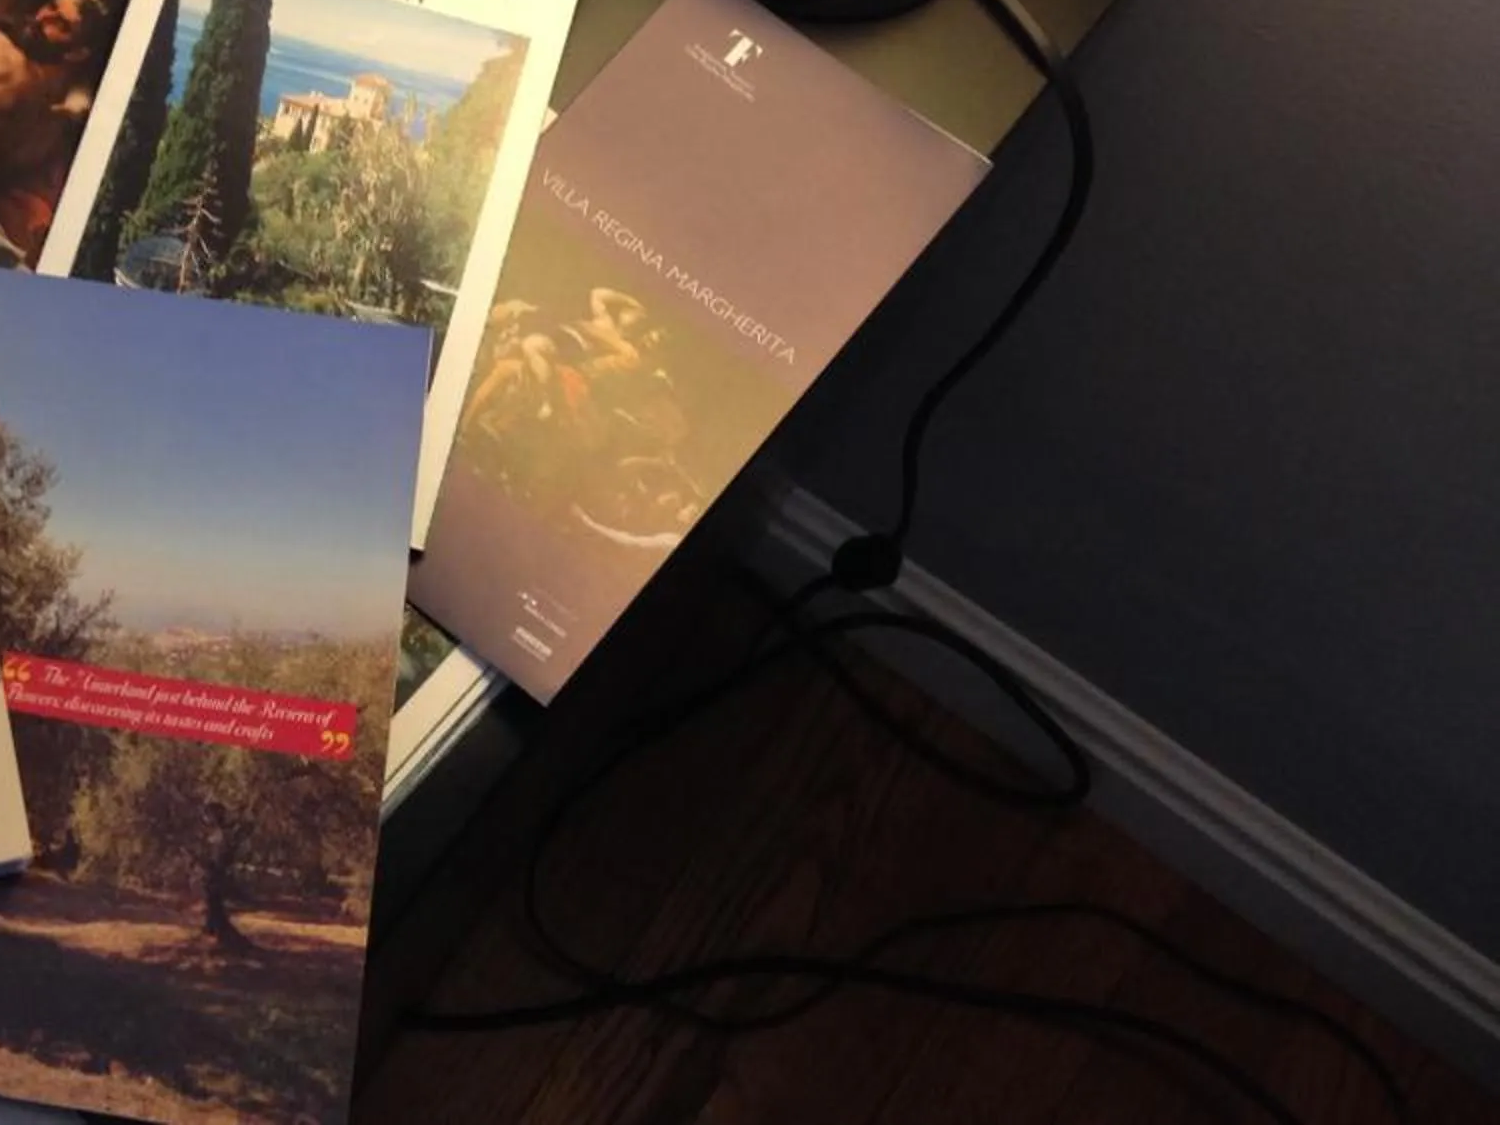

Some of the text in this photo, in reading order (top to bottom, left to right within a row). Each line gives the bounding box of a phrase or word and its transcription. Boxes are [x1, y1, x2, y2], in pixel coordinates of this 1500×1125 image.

[542, 169, 796, 365] VILLA REGINA MARGHERITA
[41, 662, 72, 686] The
